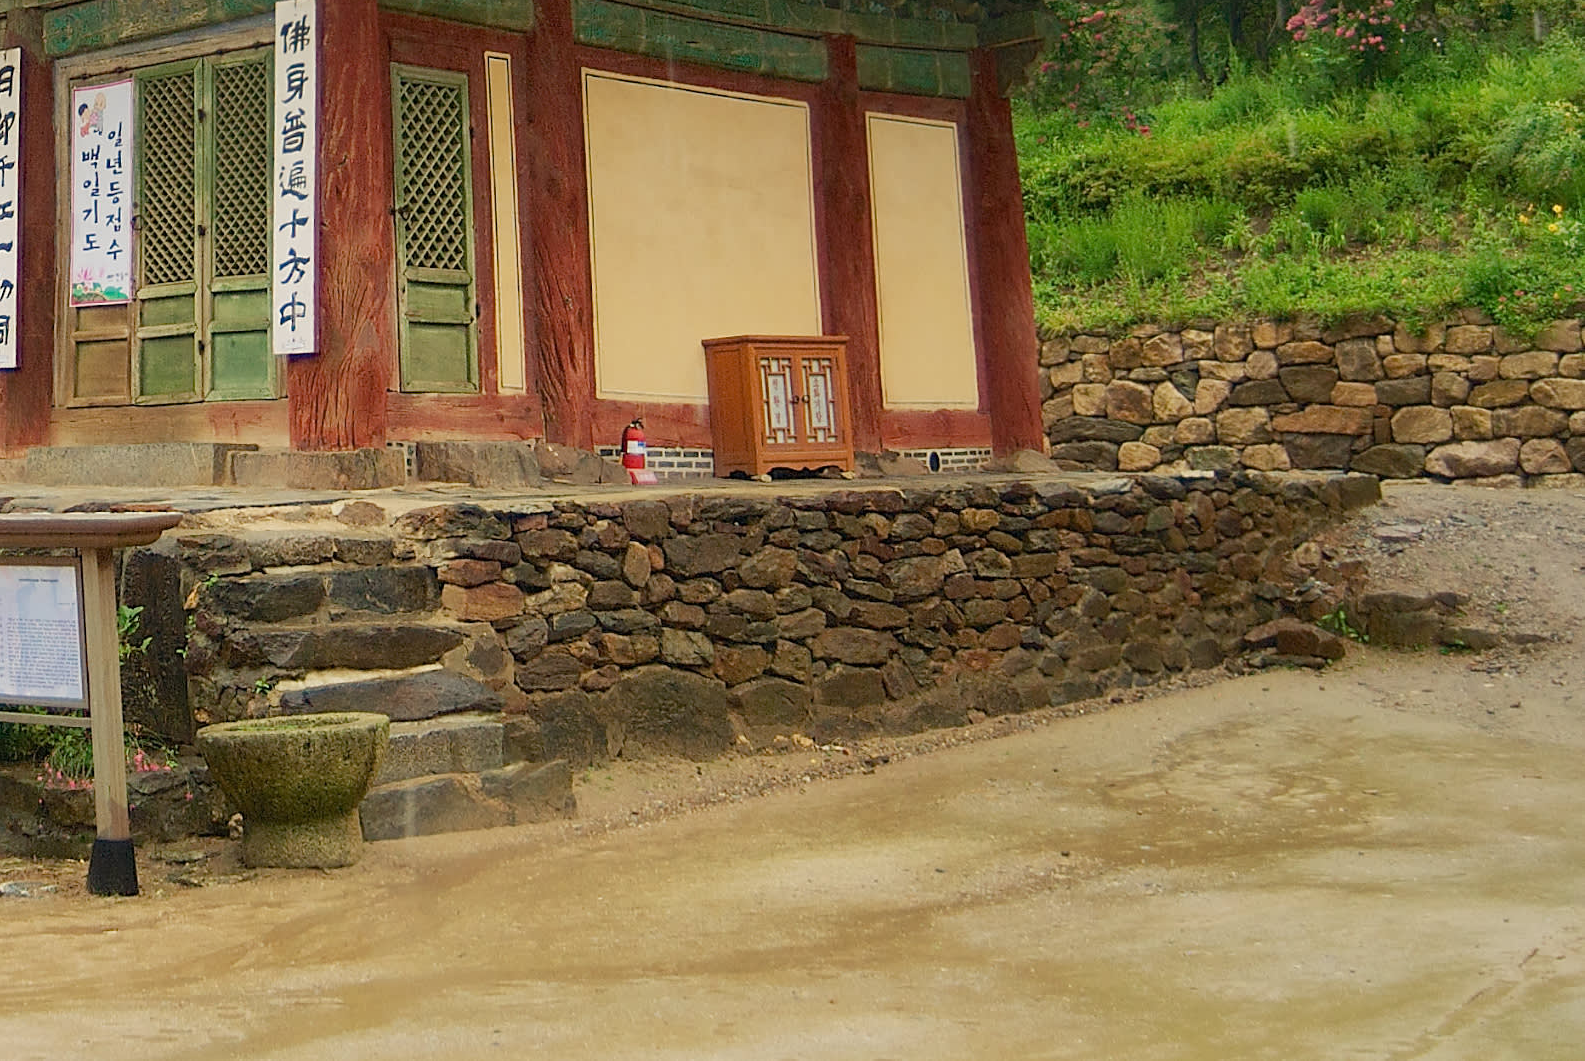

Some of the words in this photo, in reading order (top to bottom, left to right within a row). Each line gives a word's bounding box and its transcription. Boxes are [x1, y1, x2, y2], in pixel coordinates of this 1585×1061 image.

[81, 144, 101, 252] 백일기도
[105, 121, 124, 260] 일년등접수
[278, 14, 311, 332] 佛身普遍十方中
